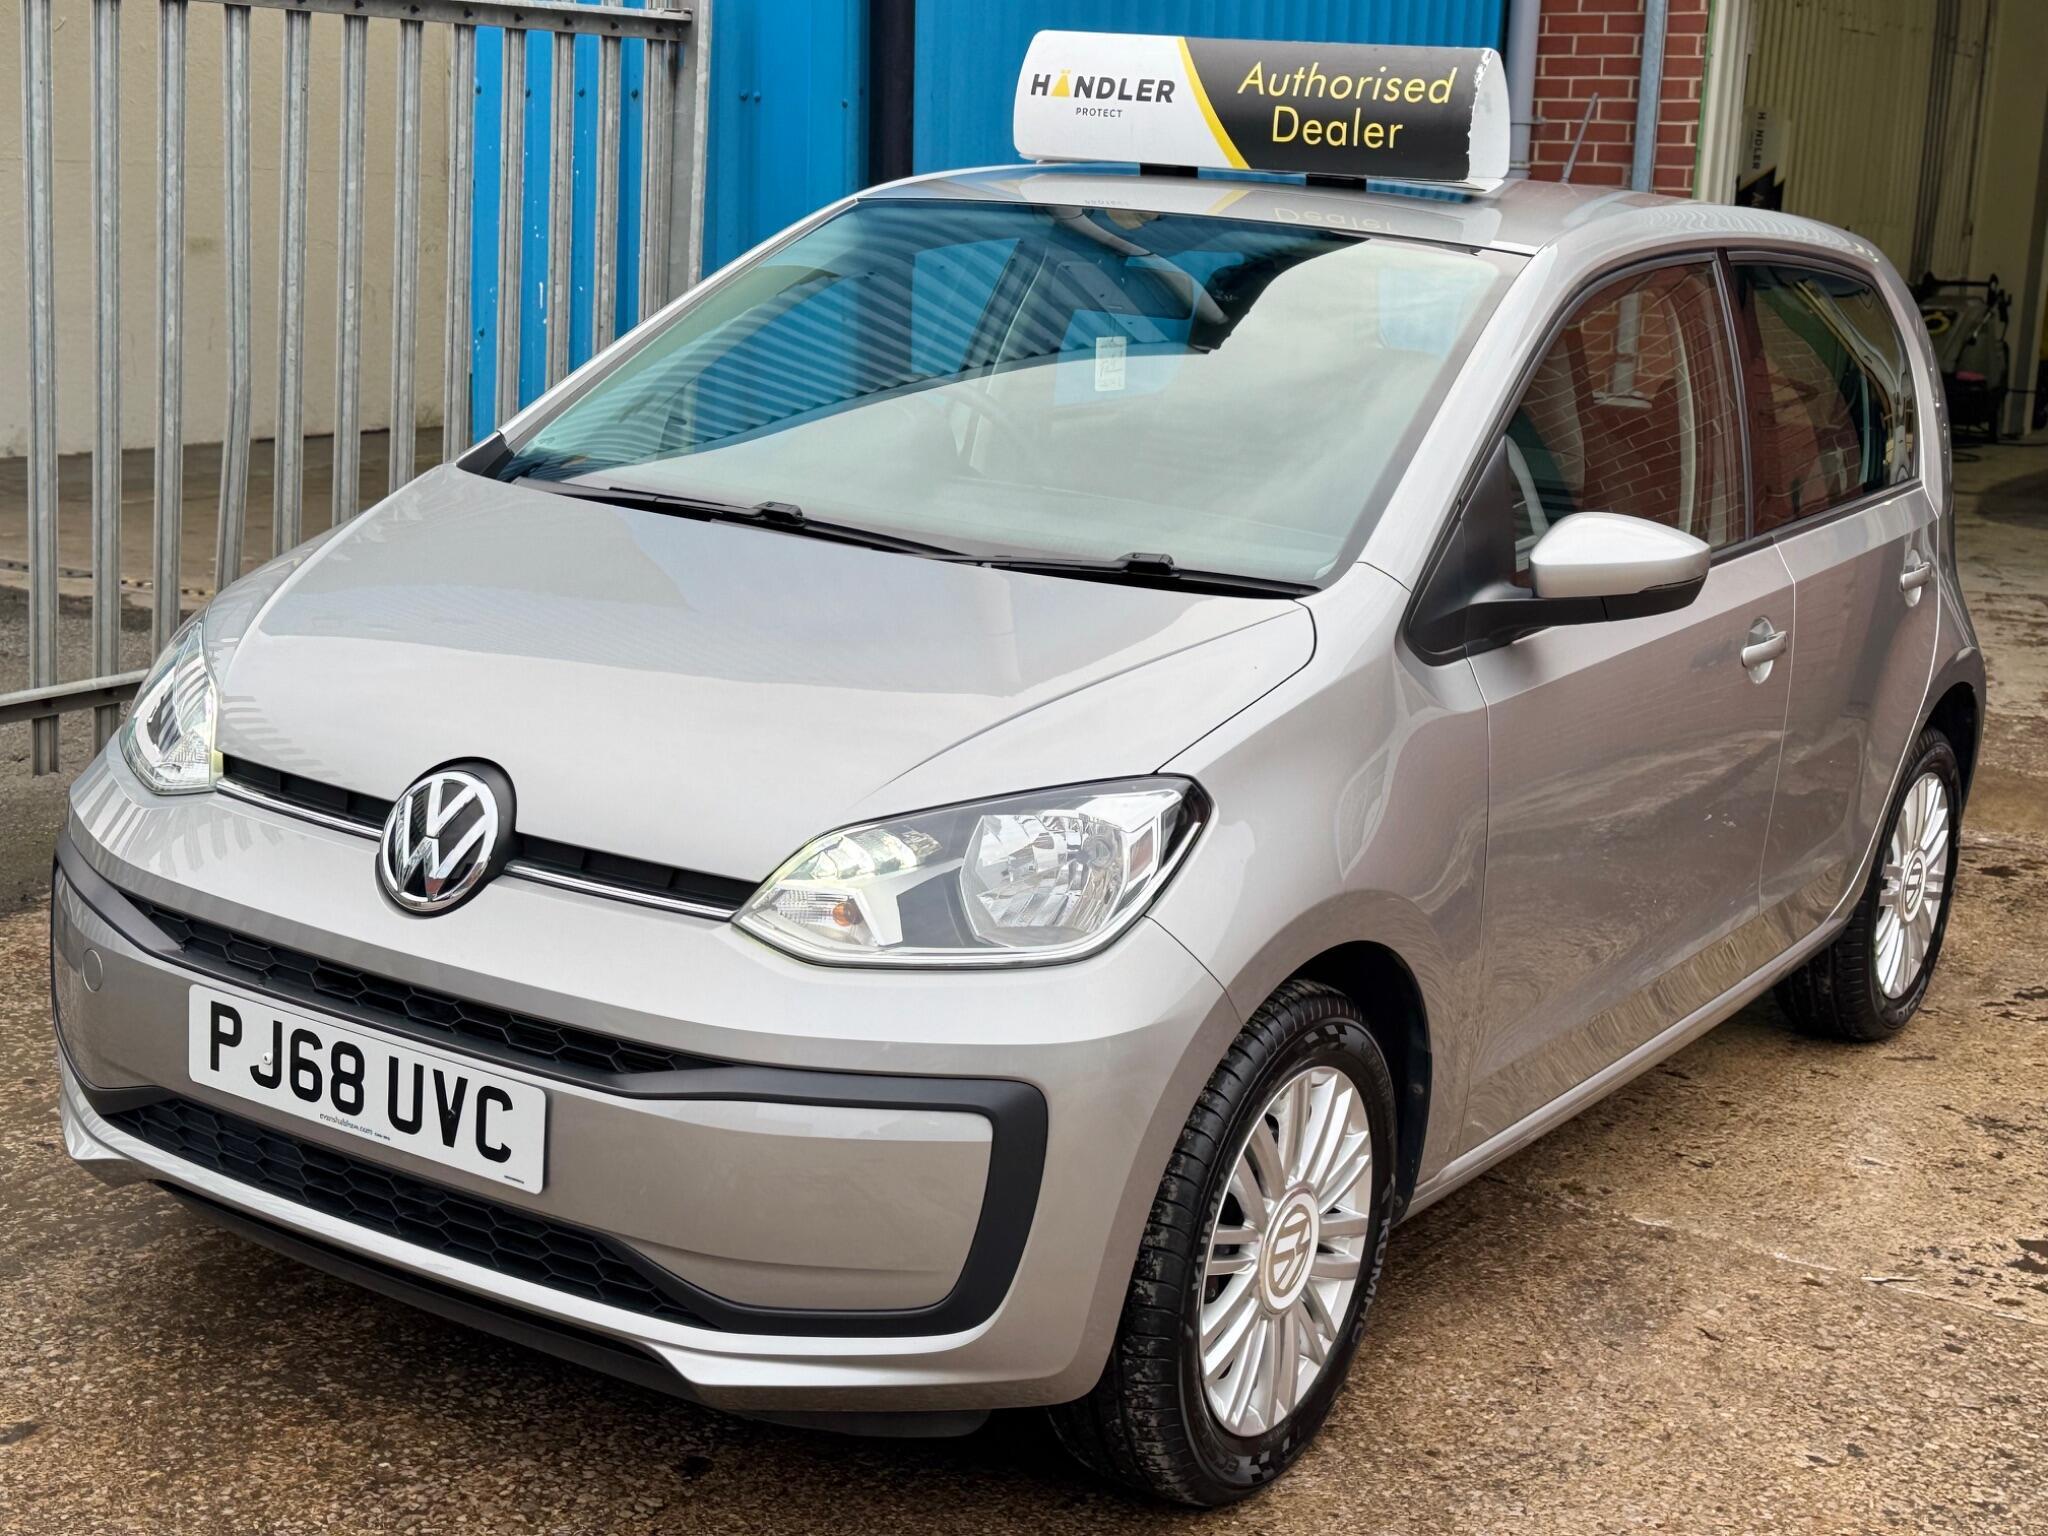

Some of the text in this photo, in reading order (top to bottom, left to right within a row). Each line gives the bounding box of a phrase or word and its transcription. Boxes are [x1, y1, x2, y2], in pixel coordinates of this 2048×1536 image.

[1236, 61, 1459, 104] Authorised
[1075, 106, 1123, 118] PROTECT
[1271, 105, 1404, 149] Dealer
[209, 1000, 514, 1164] PJ68 UVC
